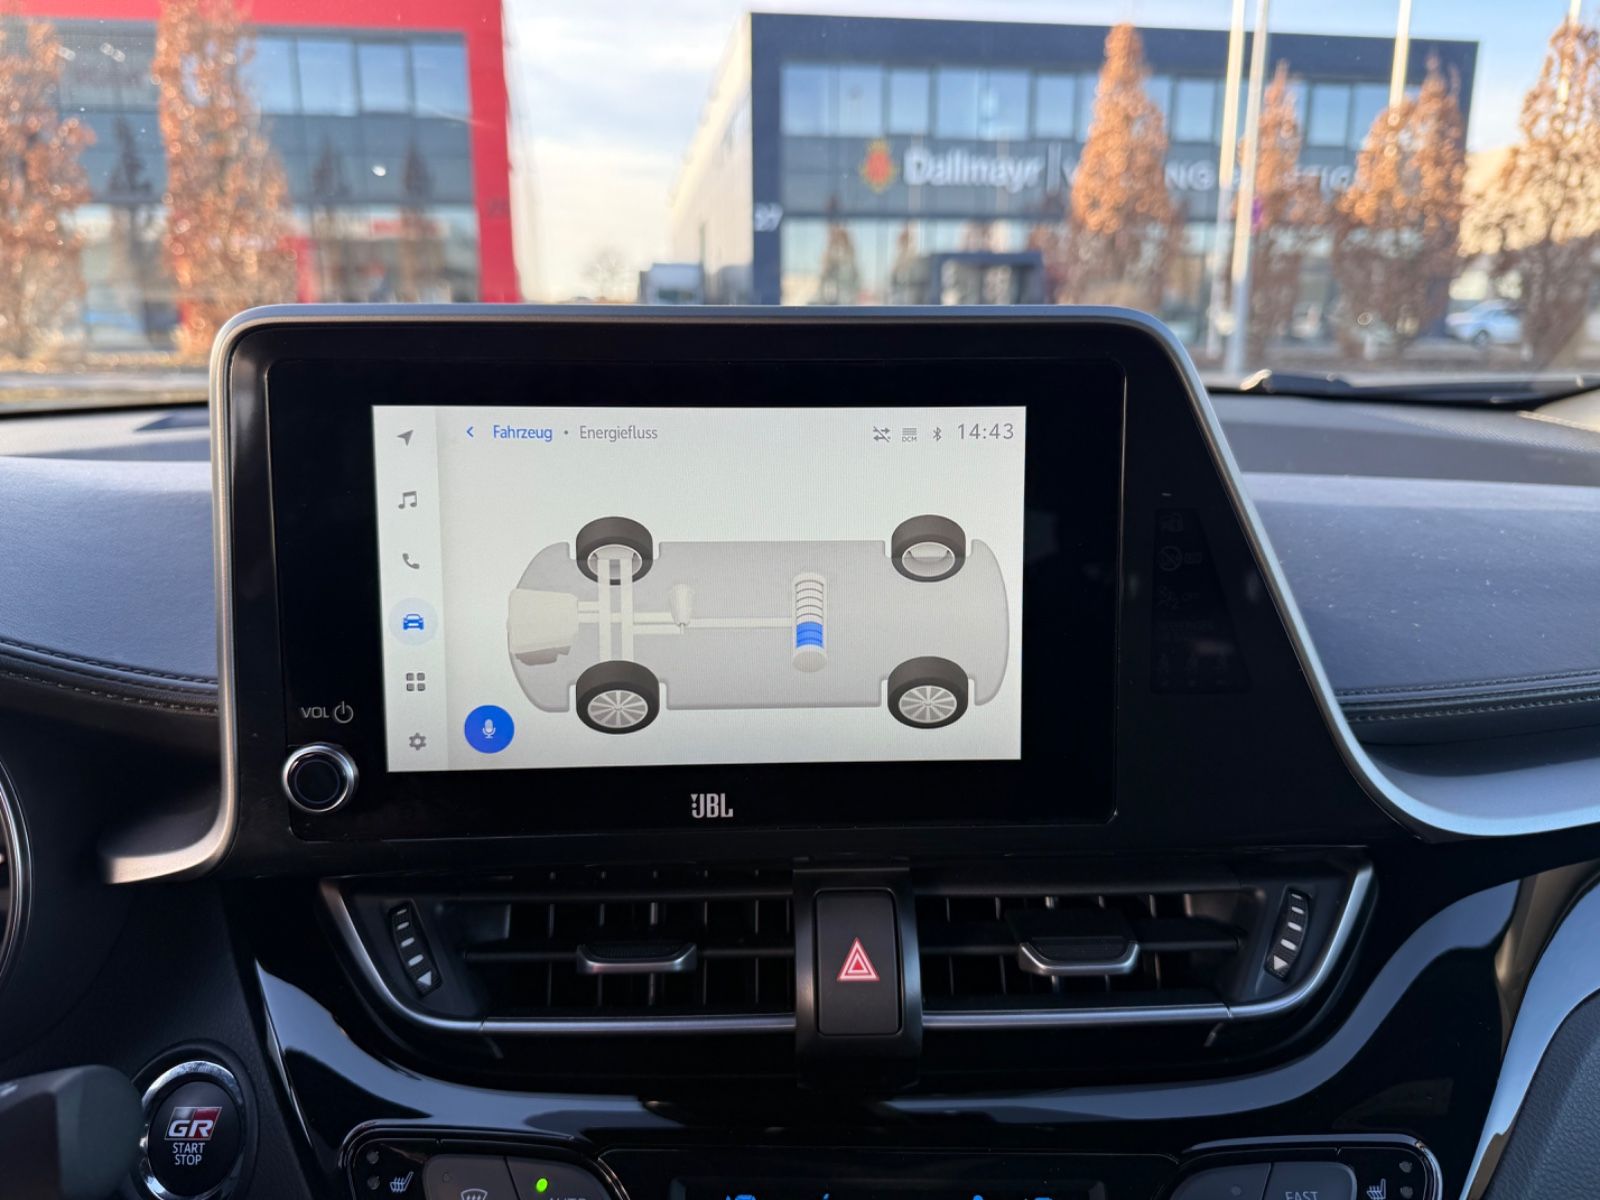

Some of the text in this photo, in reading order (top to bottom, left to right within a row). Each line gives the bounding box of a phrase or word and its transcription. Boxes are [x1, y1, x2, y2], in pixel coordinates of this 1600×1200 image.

[904, 148, 1042, 193] Dallmayr
[493, 424, 658, 442] Fahrzeug Energiefluss
[957, 423, 1014, 440] 14:43
[300, 706, 330, 718] VOL
[690, 793, 734, 818] JBL
[168, 1119, 214, 1137] GR
[172, 1142, 205, 1154] START
[174, 1154, 202, 1166] STOP
[1285, 1191, 1318, 1200] FAST
